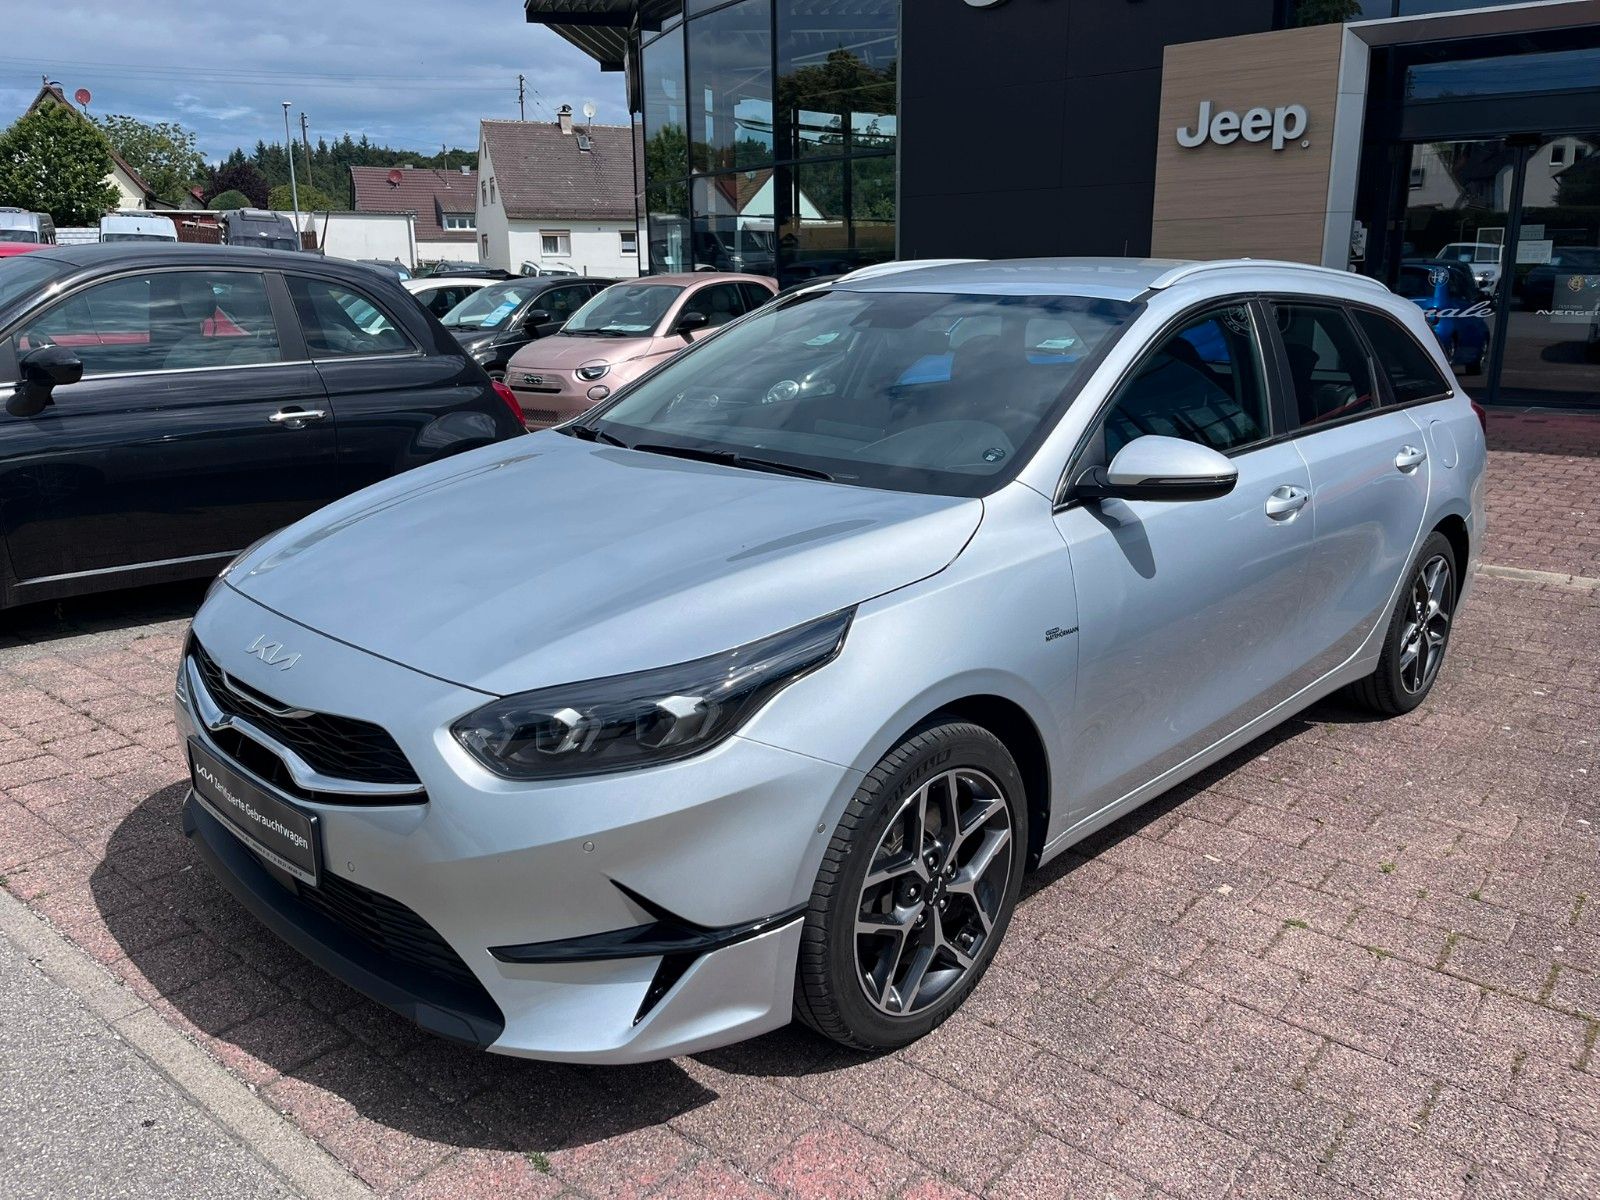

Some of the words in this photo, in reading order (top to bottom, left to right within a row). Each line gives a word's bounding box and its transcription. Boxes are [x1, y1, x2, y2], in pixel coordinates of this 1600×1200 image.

[1176, 101, 1308, 151] Jeep
[243, 634, 302, 672] KIA
[195, 763, 214, 783] KIA
[214, 777, 246, 813] Zertifizierte
[245, 803, 309, 850] Gebrauchtwagen
